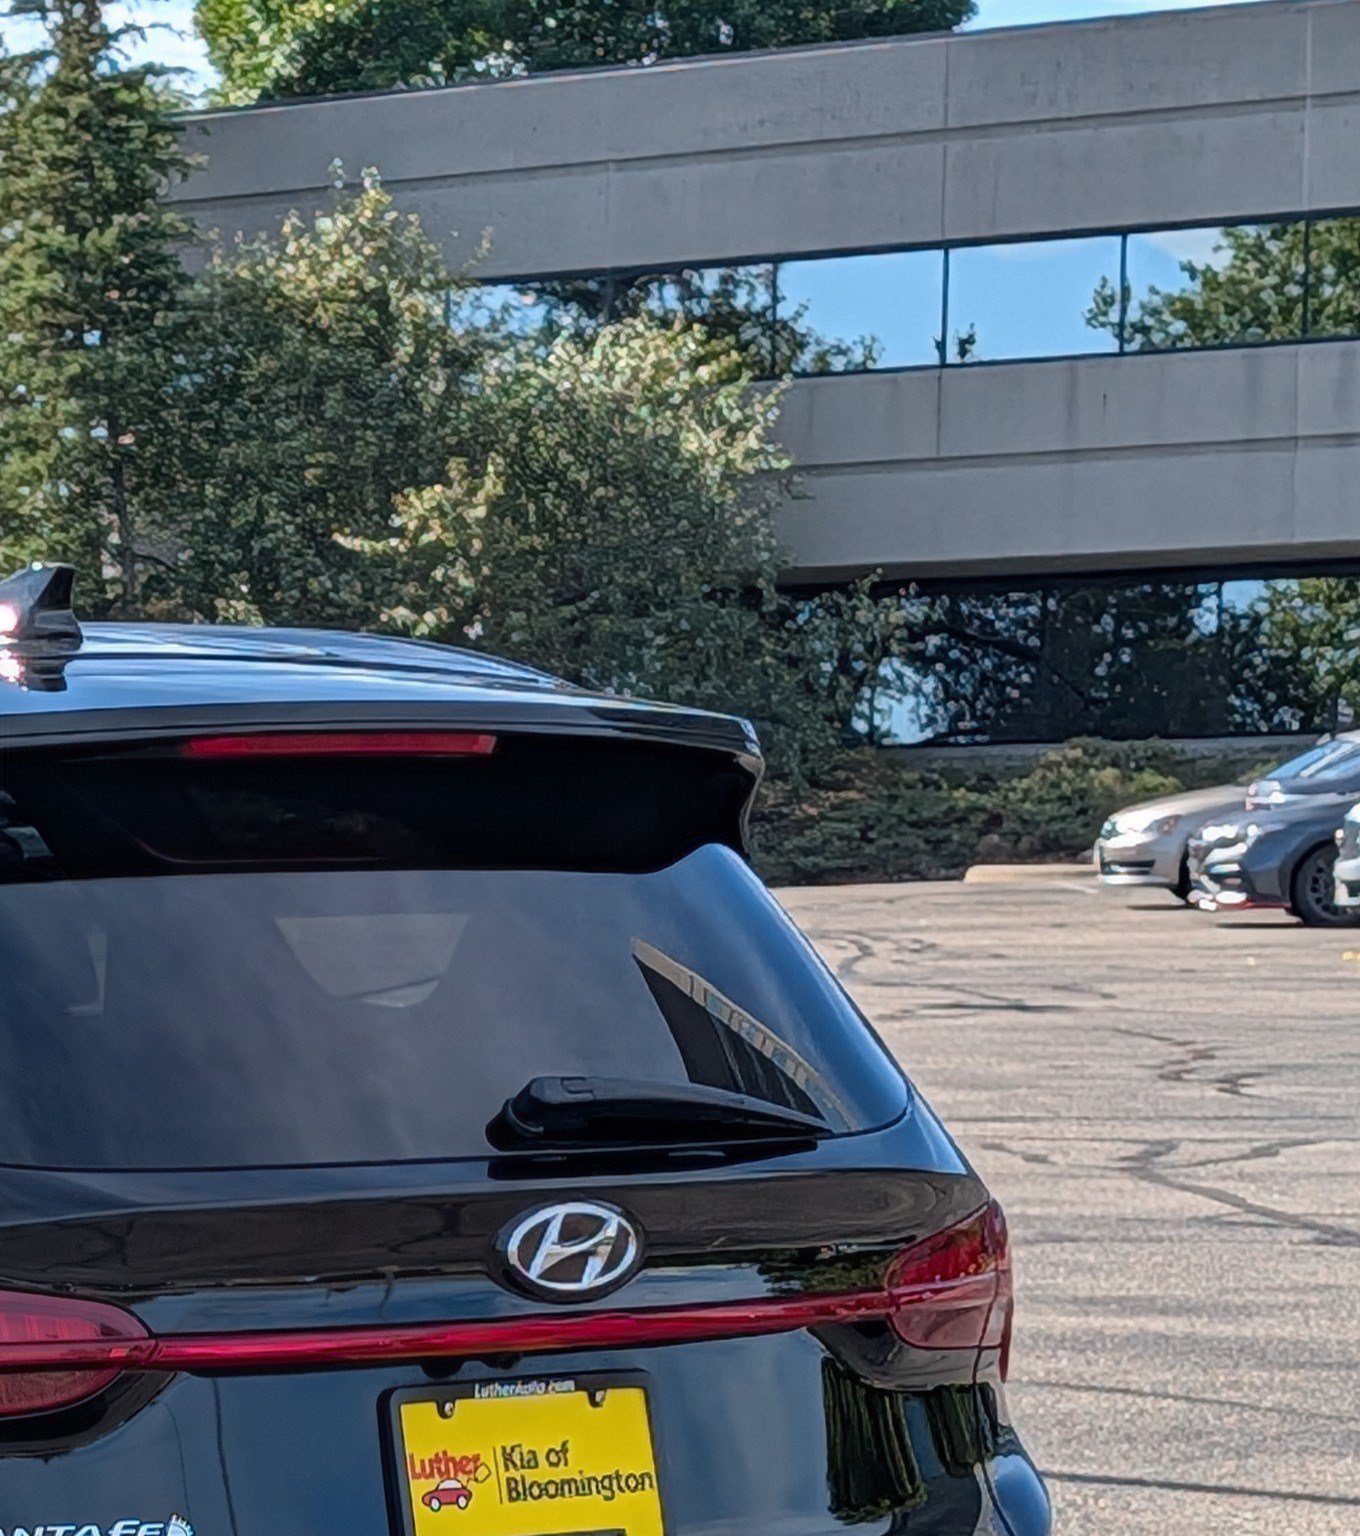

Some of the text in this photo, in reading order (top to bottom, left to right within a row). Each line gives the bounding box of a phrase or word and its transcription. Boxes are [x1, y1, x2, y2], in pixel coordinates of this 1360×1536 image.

[409, 1451, 481, 1481] Luther
[501, 1440, 569, 1472] Kia of
[507, 1469, 654, 1503] Bloomington
